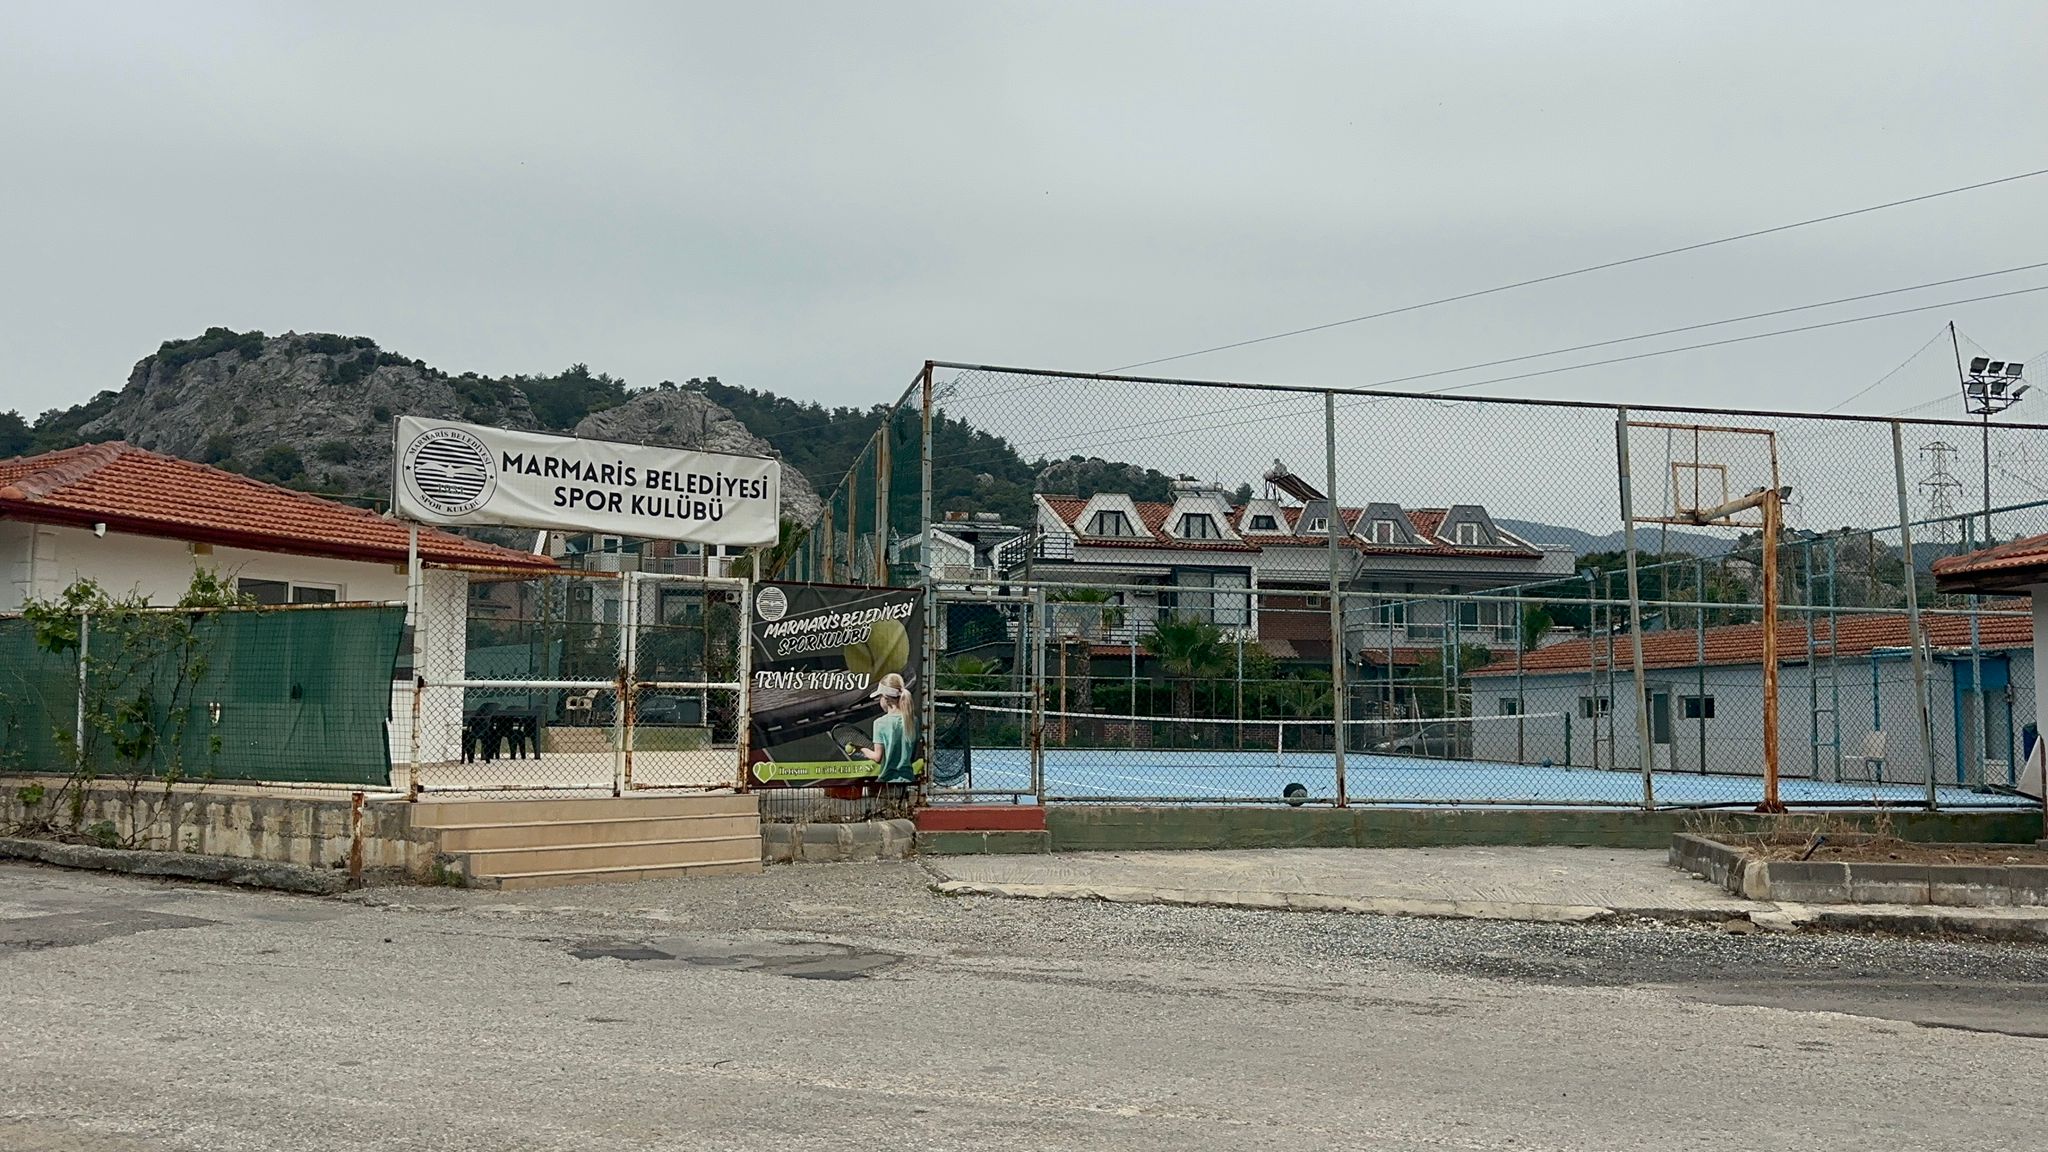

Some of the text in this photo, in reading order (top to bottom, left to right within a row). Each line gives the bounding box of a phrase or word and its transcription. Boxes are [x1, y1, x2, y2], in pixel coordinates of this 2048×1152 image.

[409, 430, 492, 465] MARMARİS BELEDİYESİ
[502, 451, 768, 500] MARMARİS BELEDİYESİ
[419, 494, 442, 510] SPOR
[554, 486, 723, 522] SPOR KULÜBÜ
[764, 597, 914, 639] MARMARİS BELEDİYESİ
[777, 626, 871, 655] SPOR KULÜBÜ
[755, 667, 870, 691] TENİS KURSU
